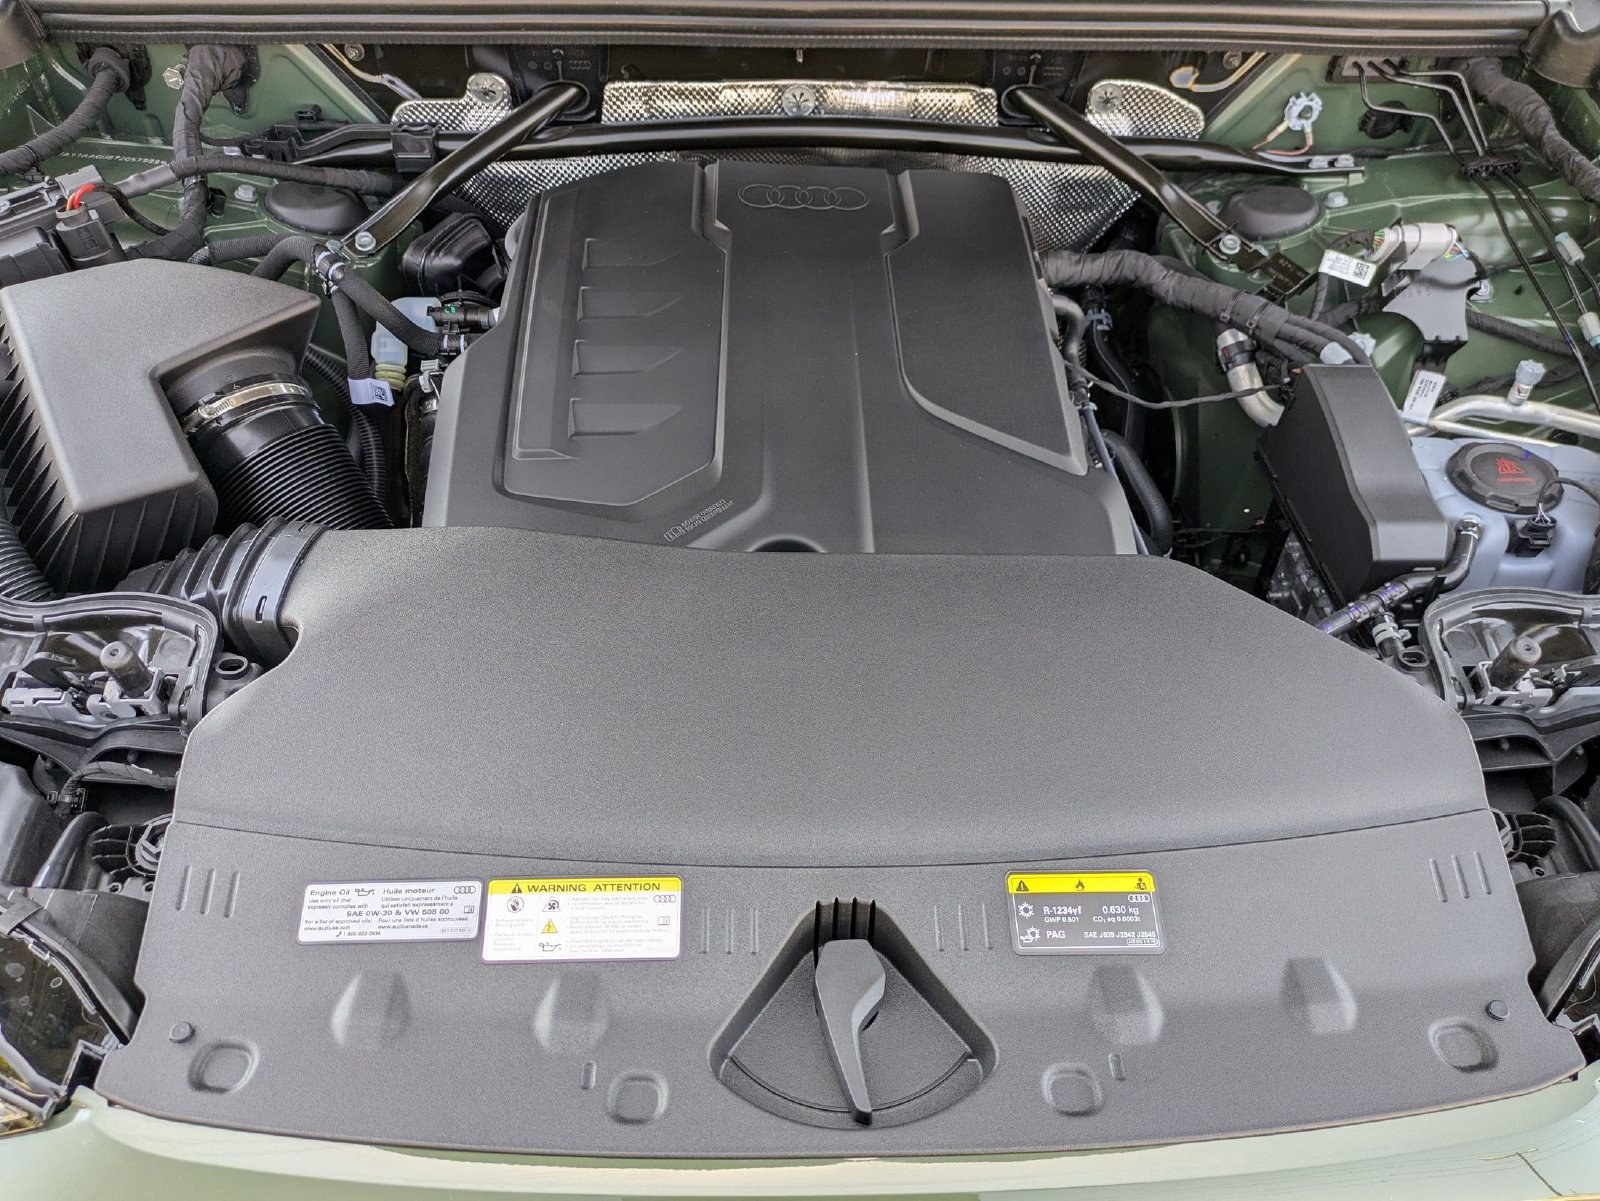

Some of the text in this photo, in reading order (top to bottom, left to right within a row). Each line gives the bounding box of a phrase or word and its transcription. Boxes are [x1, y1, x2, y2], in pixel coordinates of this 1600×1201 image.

[527, 883, 661, 893] WARNING ATTENTION
[1043, 905, 1082, 916] R-1234yf
[1102, 906, 1139, 915] 0.630 kg
[1046, 930, 1066, 938] PAG
